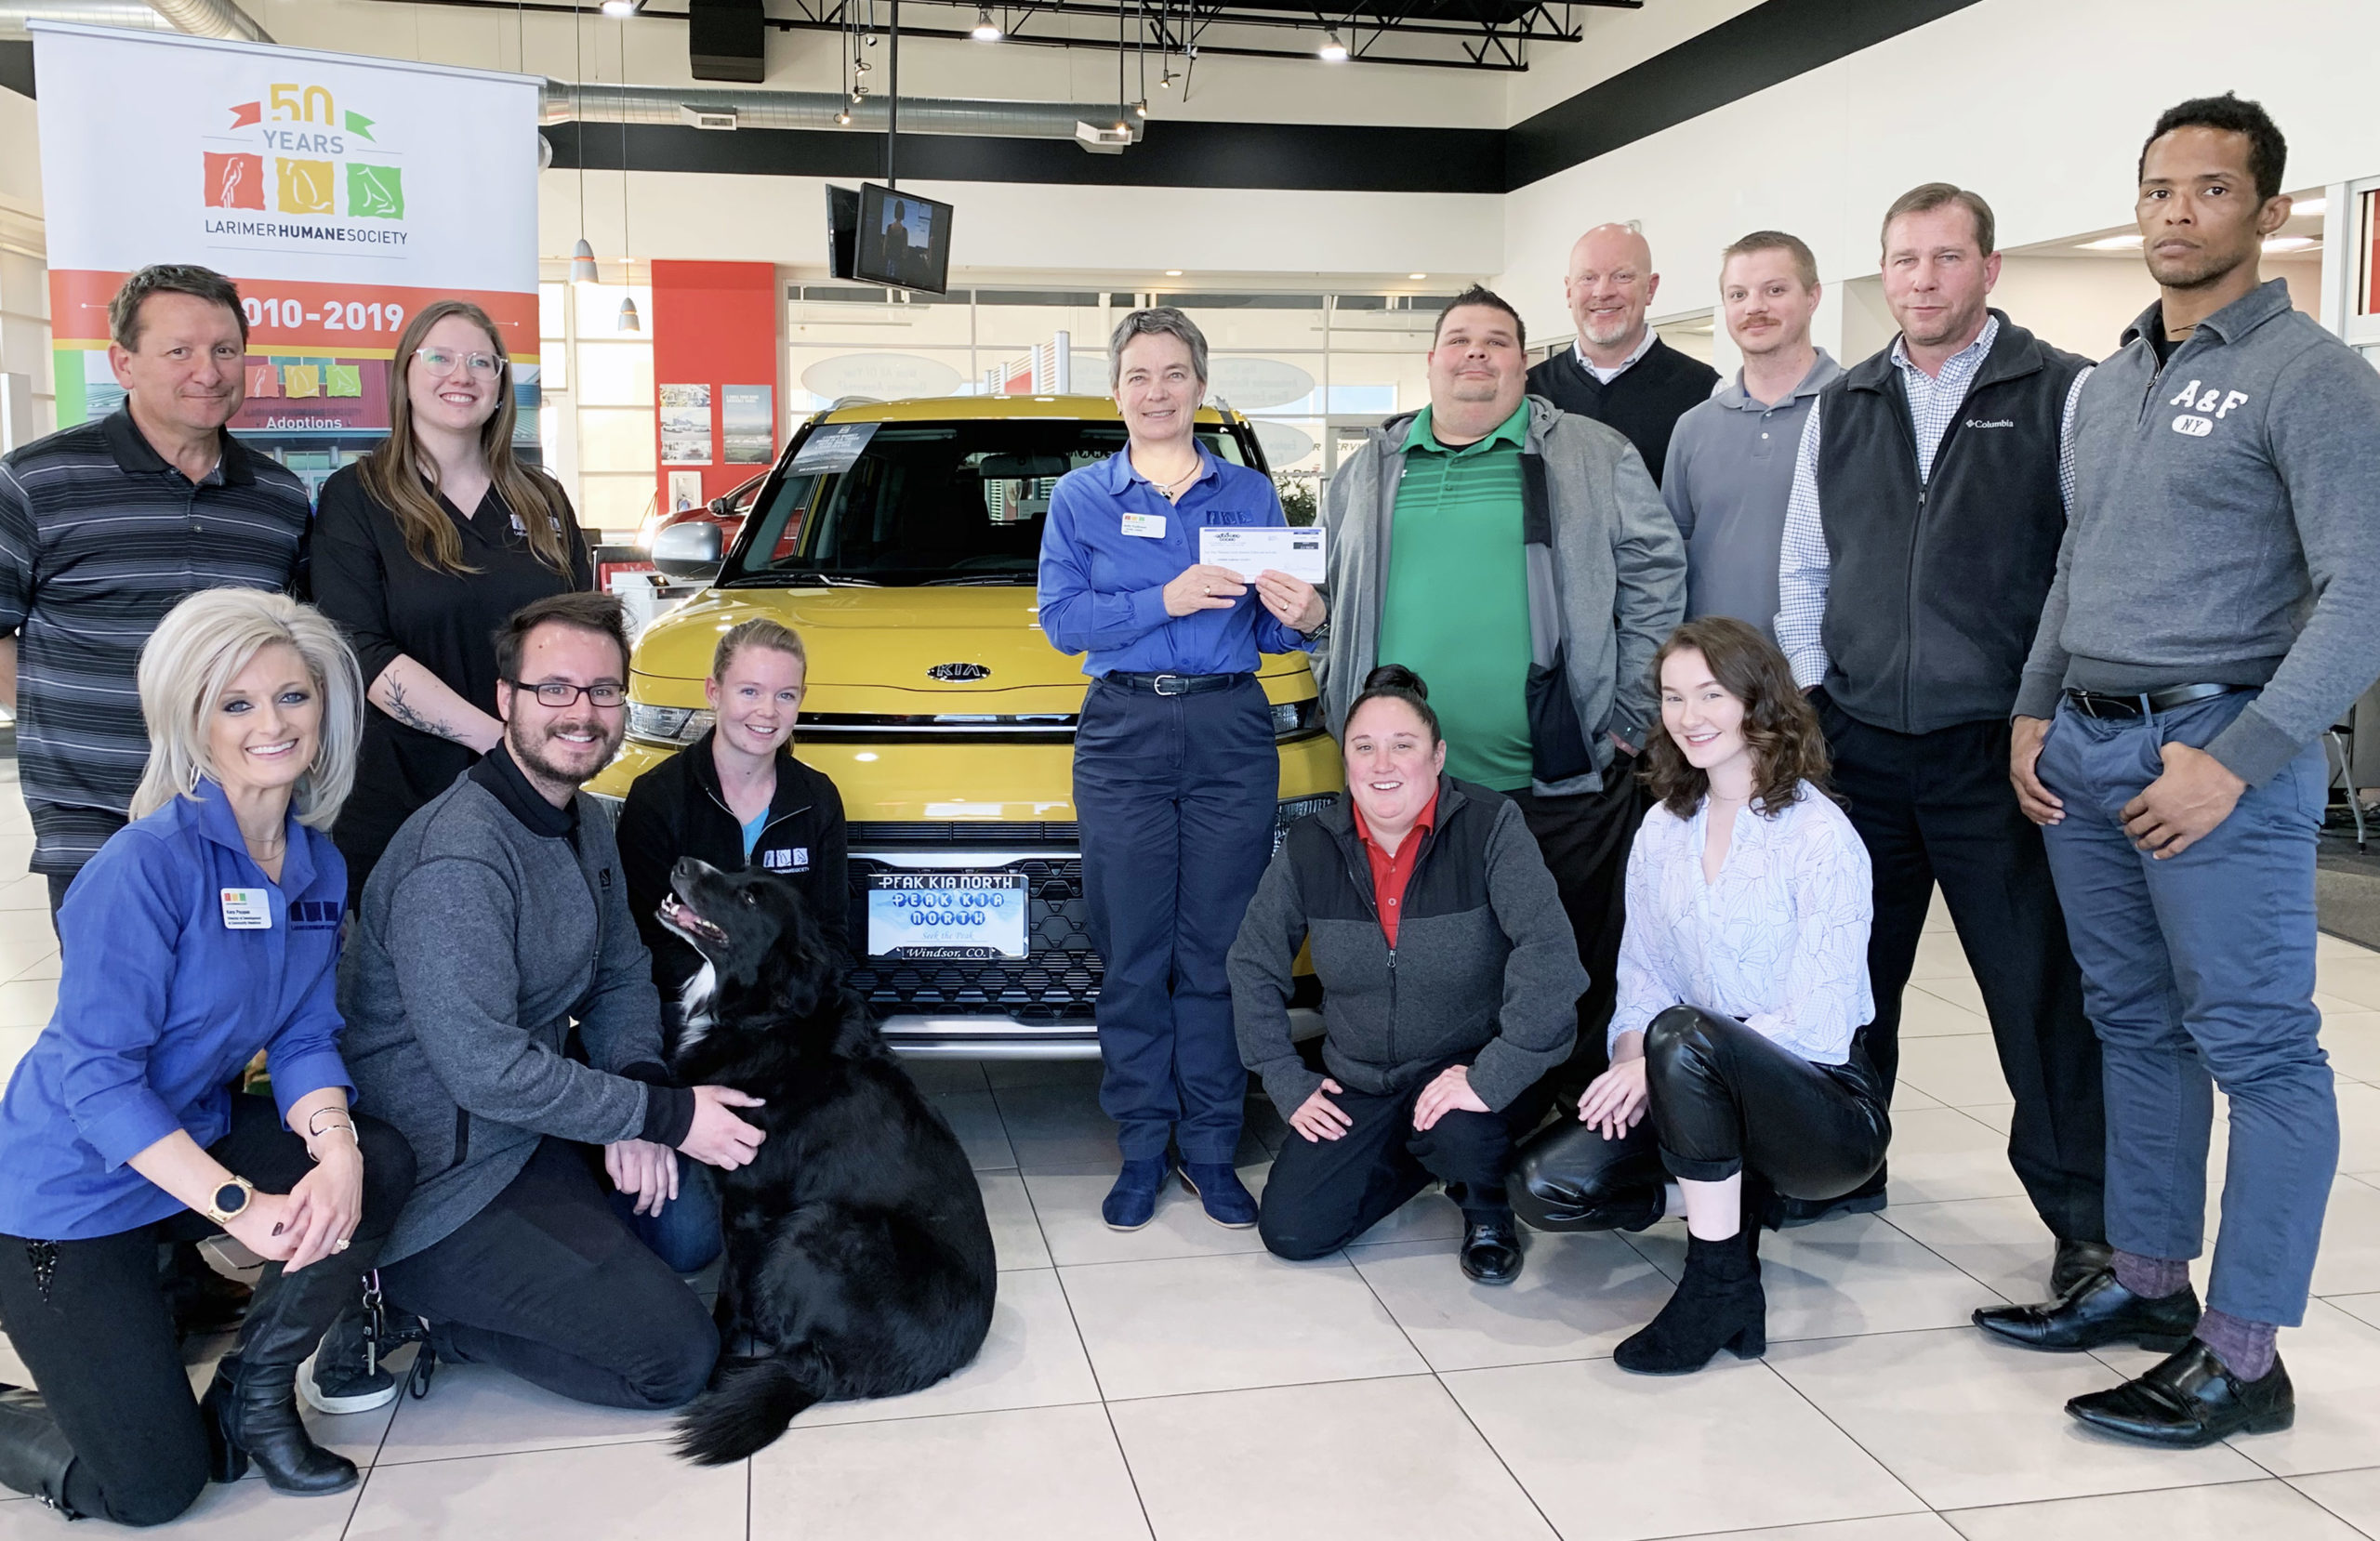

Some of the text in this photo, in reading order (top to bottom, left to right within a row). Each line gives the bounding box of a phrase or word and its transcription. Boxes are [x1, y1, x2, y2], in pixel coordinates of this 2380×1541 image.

[270, 83, 335, 126] 50
[263, 129, 344, 154] YEARS
[242, 296, 404, 332] 010-2019
[2170, 379, 2249, 418] A&F
[266, 415, 343, 431] Adoptions
[1975, 418, 2014, 428] Columbia
[2181, 418, 2204, 433] NY
[936, 663, 981, 677] KIA
[879, 876, 1012, 889] PEAK KIA NORTH
[892, 893, 1004, 907] PEAK KIA
[911, 911, 985, 926] NORTH
[922, 931, 973, 941] Seek the Peak
[966, 948, 986, 957] CO.
